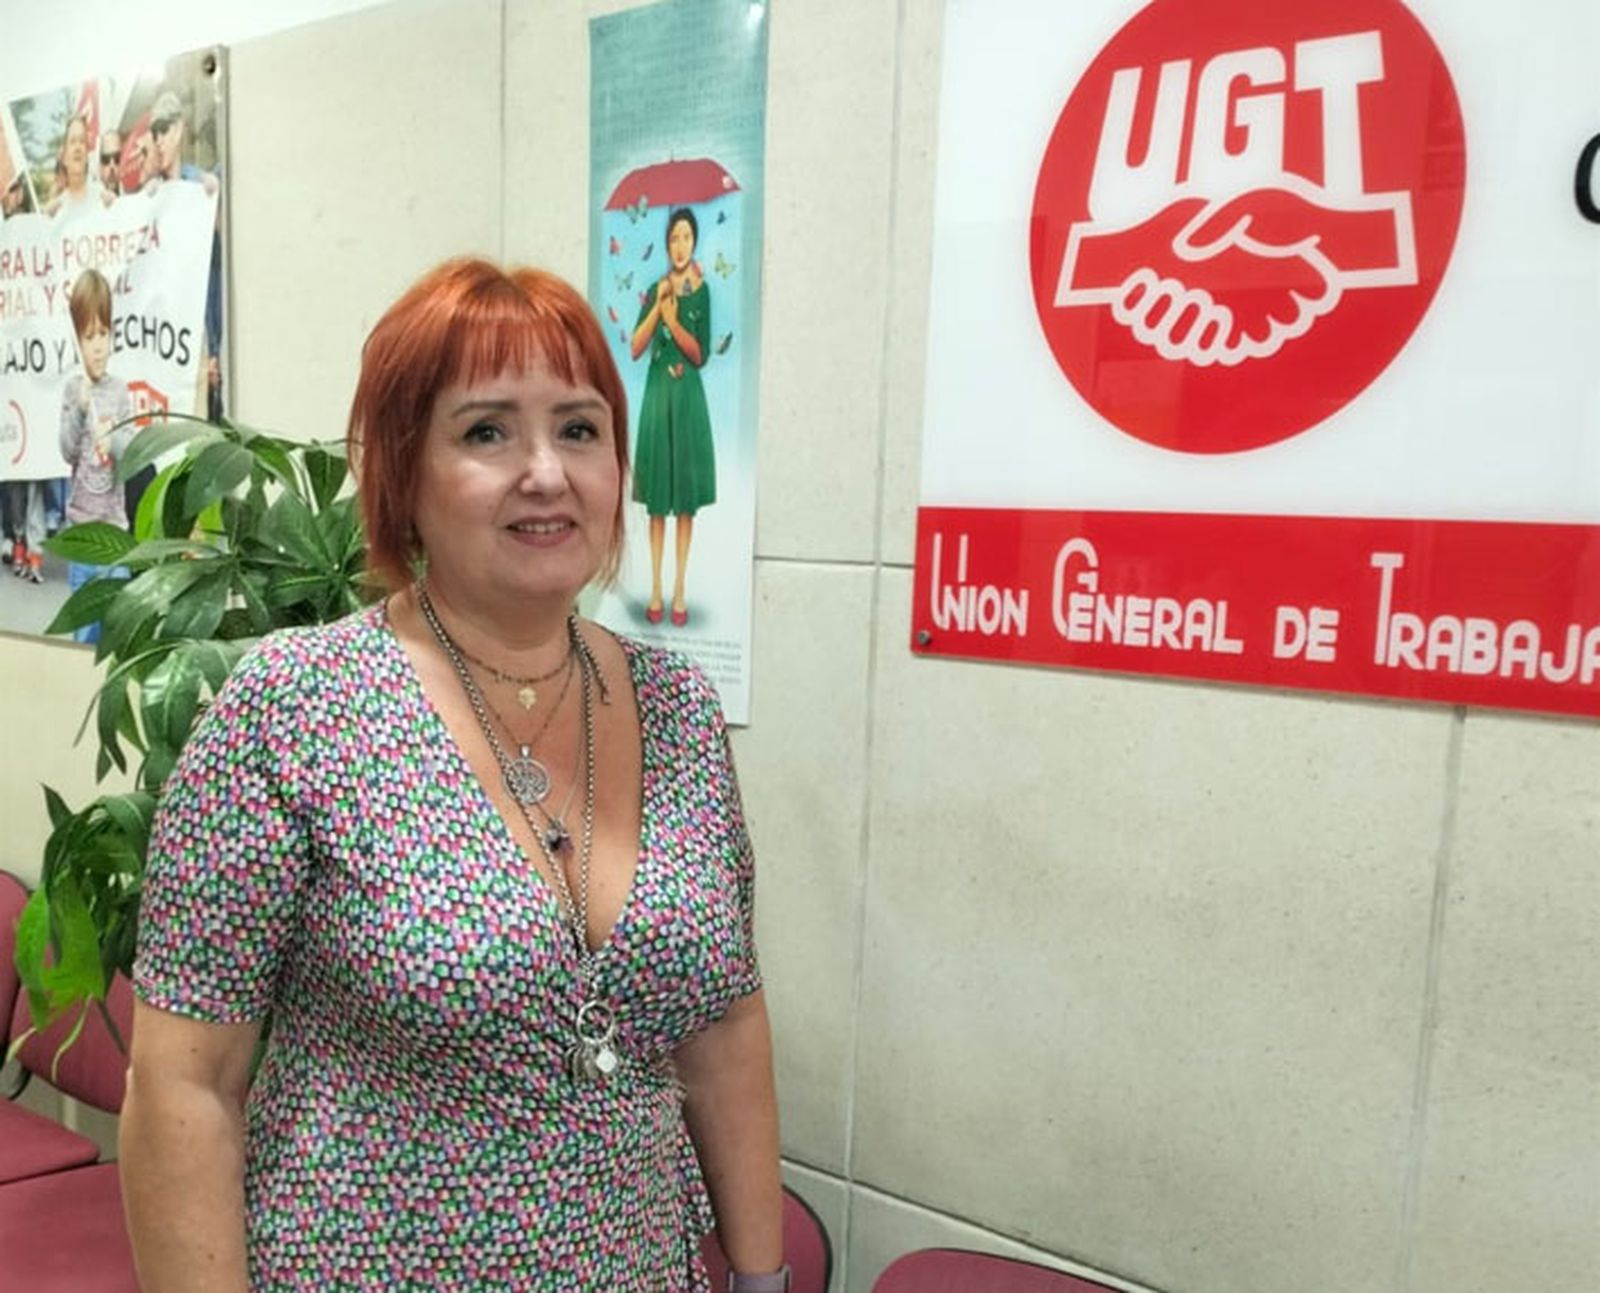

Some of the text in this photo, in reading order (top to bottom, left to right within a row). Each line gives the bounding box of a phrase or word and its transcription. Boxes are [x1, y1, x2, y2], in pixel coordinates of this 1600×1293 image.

[1088, 30, 1384, 222] UGT
[33, 246, 53, 277] LA
[62, 218, 160, 271] POBREZA
[43, 284, 56, 317] Y
[53, 338, 66, 375] Y
[1052, 537, 1244, 654] GENERAL
[1273, 606, 1340, 662] DE
